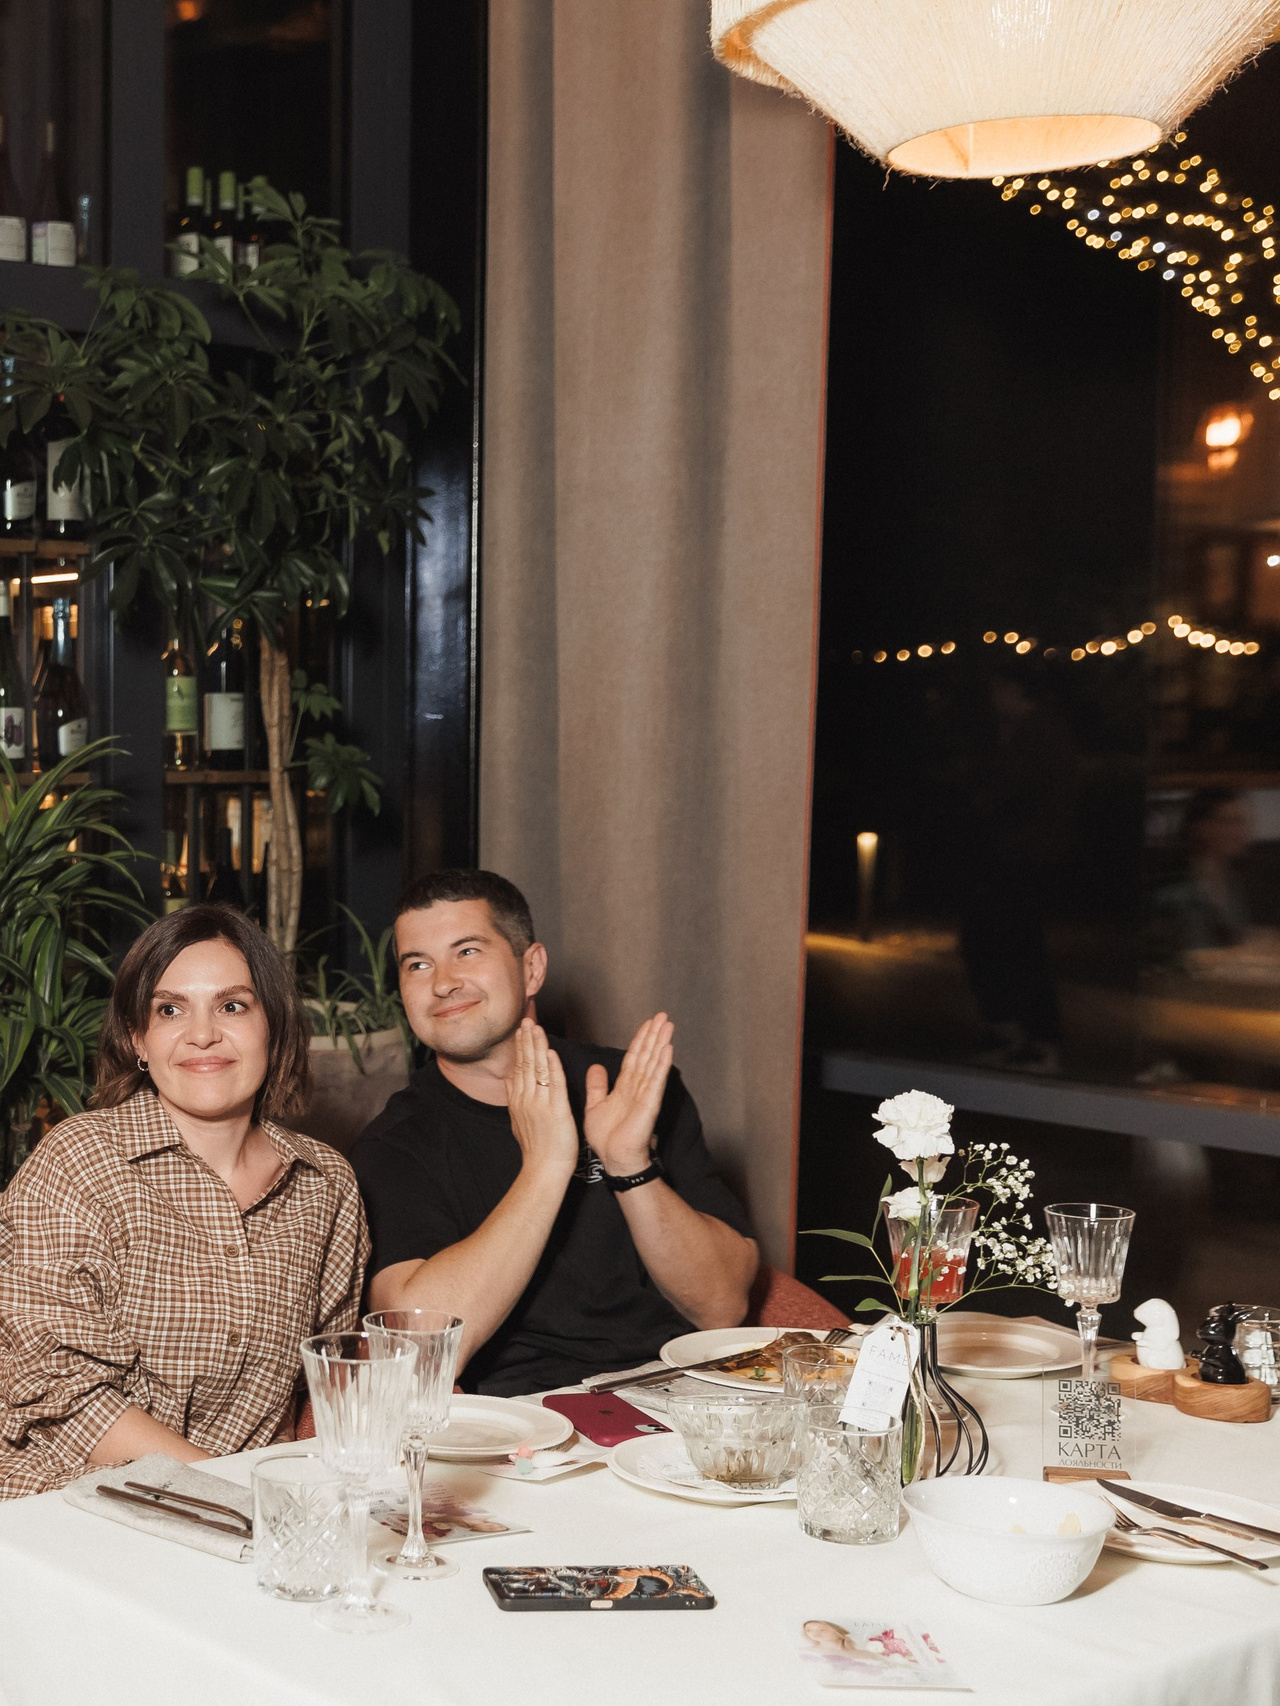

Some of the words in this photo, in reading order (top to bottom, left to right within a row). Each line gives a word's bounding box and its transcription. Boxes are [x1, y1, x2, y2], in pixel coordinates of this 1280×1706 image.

[869, 1345, 910, 1367] FAME
[1058, 1441, 1122, 1460] КАРТА
[1058, 1458, 1123, 1470] ЛОЯЛЬНОСТИ
